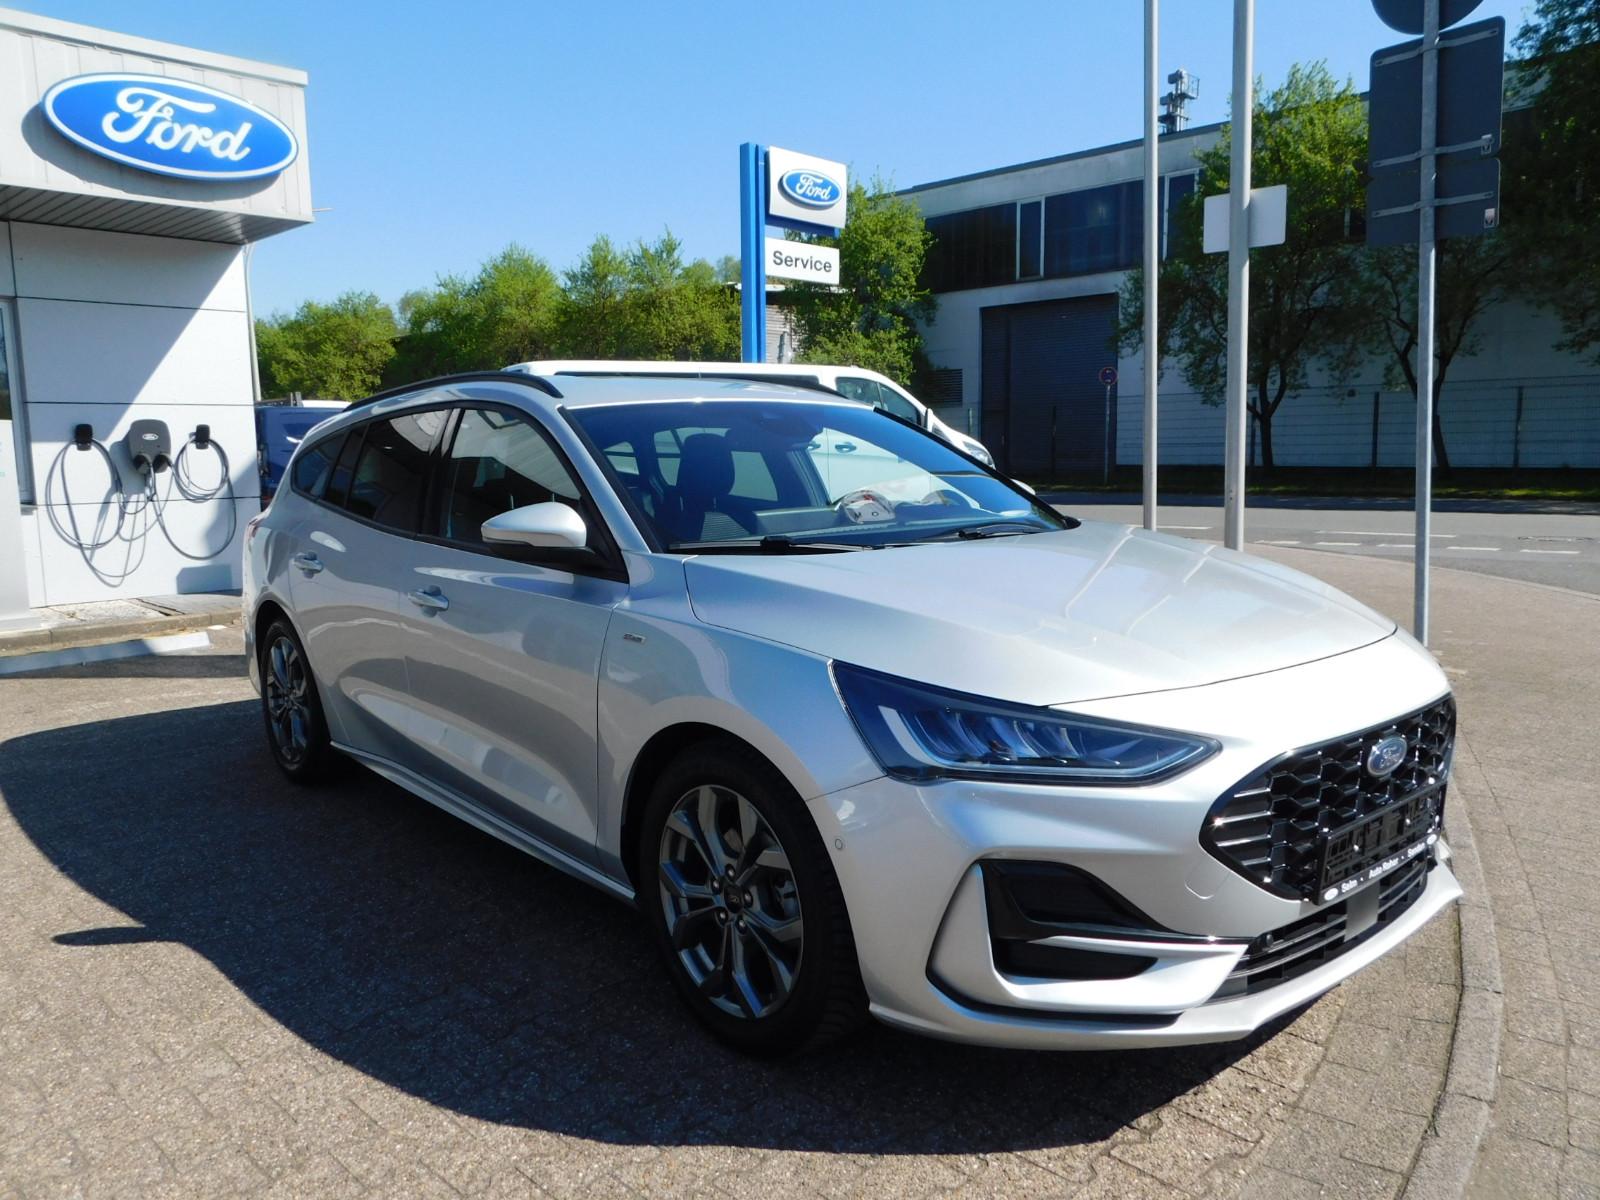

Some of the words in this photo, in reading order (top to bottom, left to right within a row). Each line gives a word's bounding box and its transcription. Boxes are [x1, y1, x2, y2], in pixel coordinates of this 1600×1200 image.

[102, 87, 252, 161] Ford
[795, 173, 831, 200] Ford
[772, 250, 832, 273] Service
